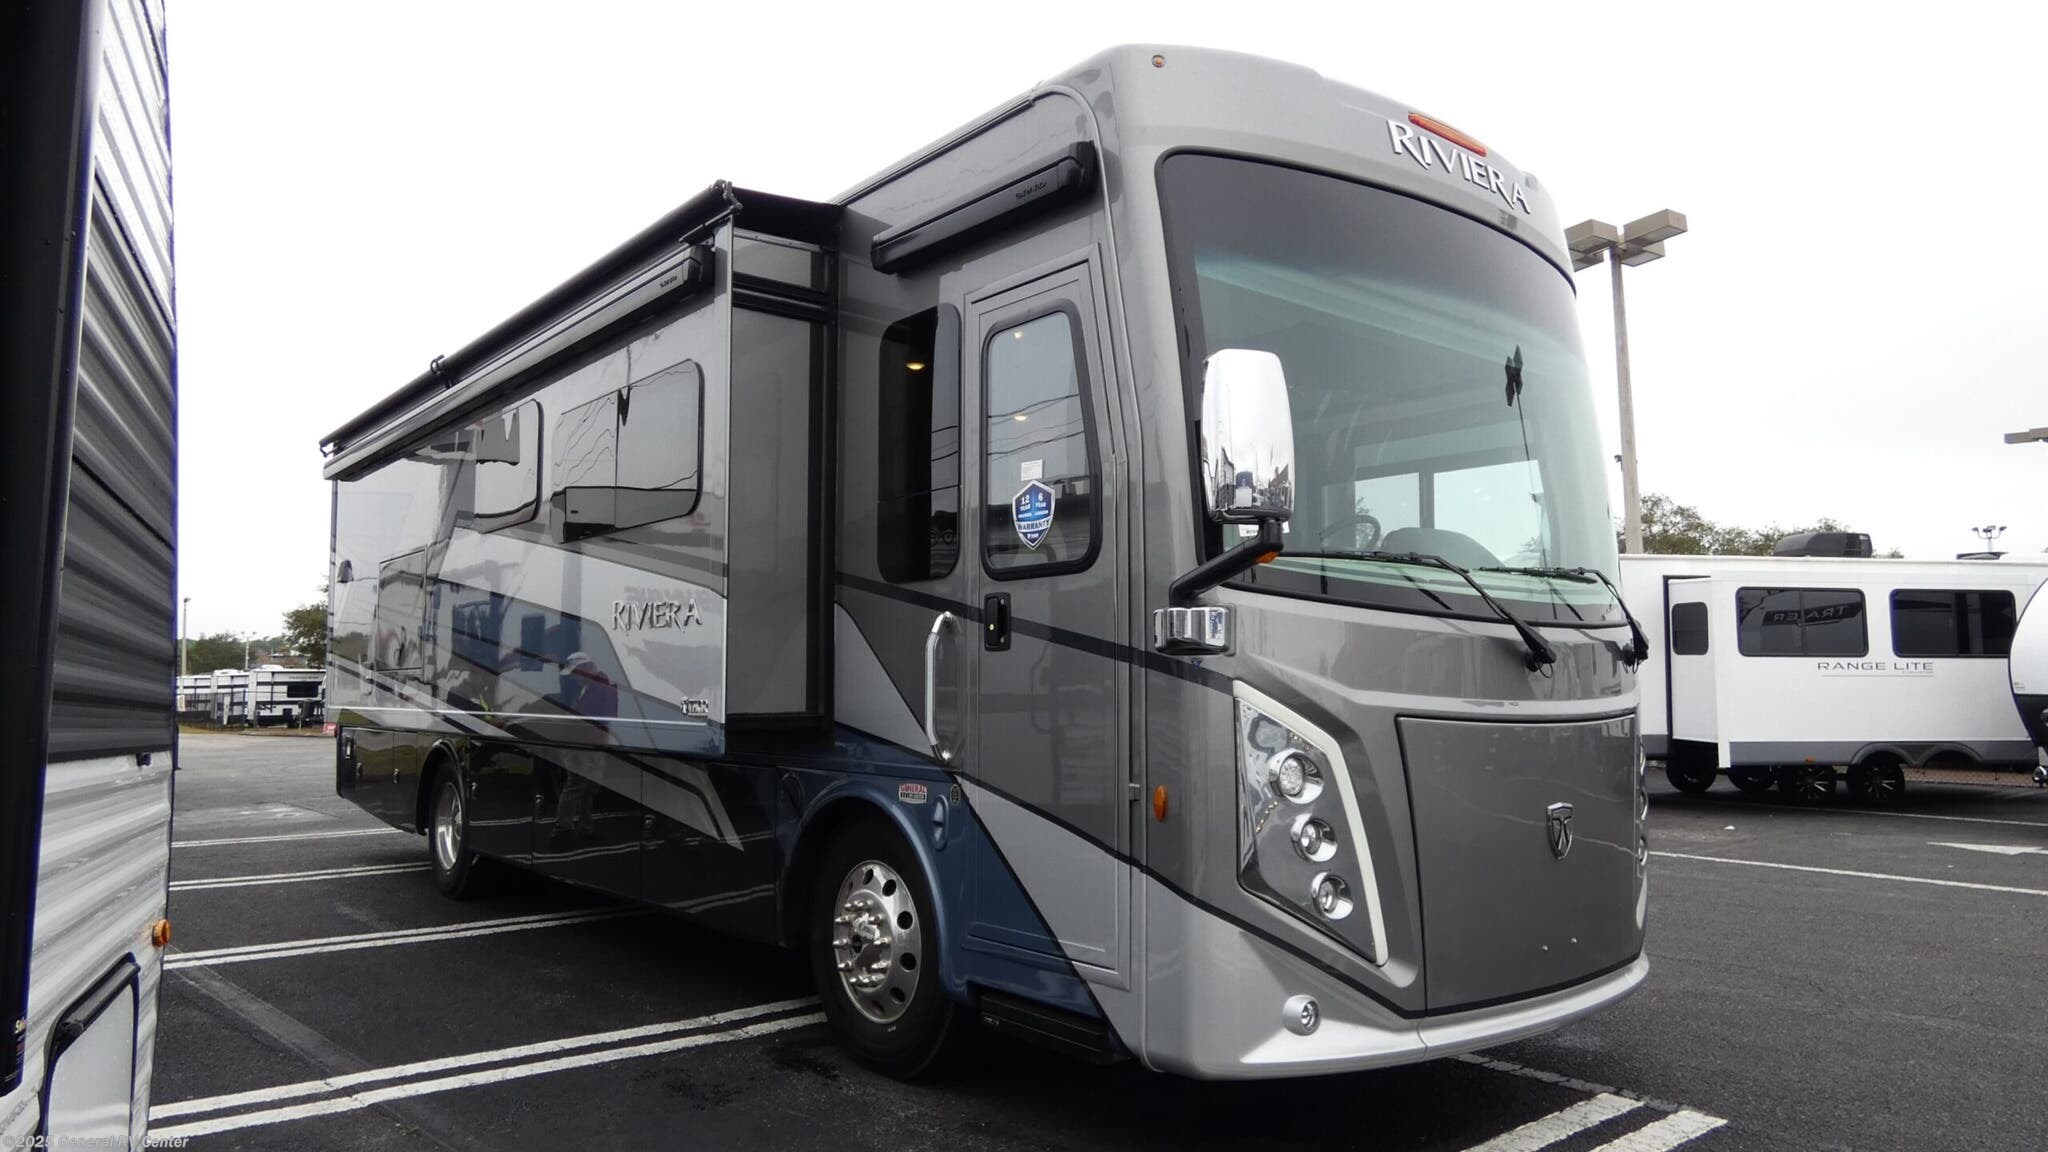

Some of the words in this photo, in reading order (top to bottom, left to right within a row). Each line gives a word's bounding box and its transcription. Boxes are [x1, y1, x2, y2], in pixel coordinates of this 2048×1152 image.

[1386, 119, 1532, 215] RIVIERA
[1021, 494, 1030, 505] 12
[1038, 492, 1044, 501] 6
[1016, 520, 1050, 531] WARRANTY
[613, 599, 703, 633] RIVIERA
[1817, 662, 1886, 671] RANGE
[1893, 662, 1934, 671] LITE
